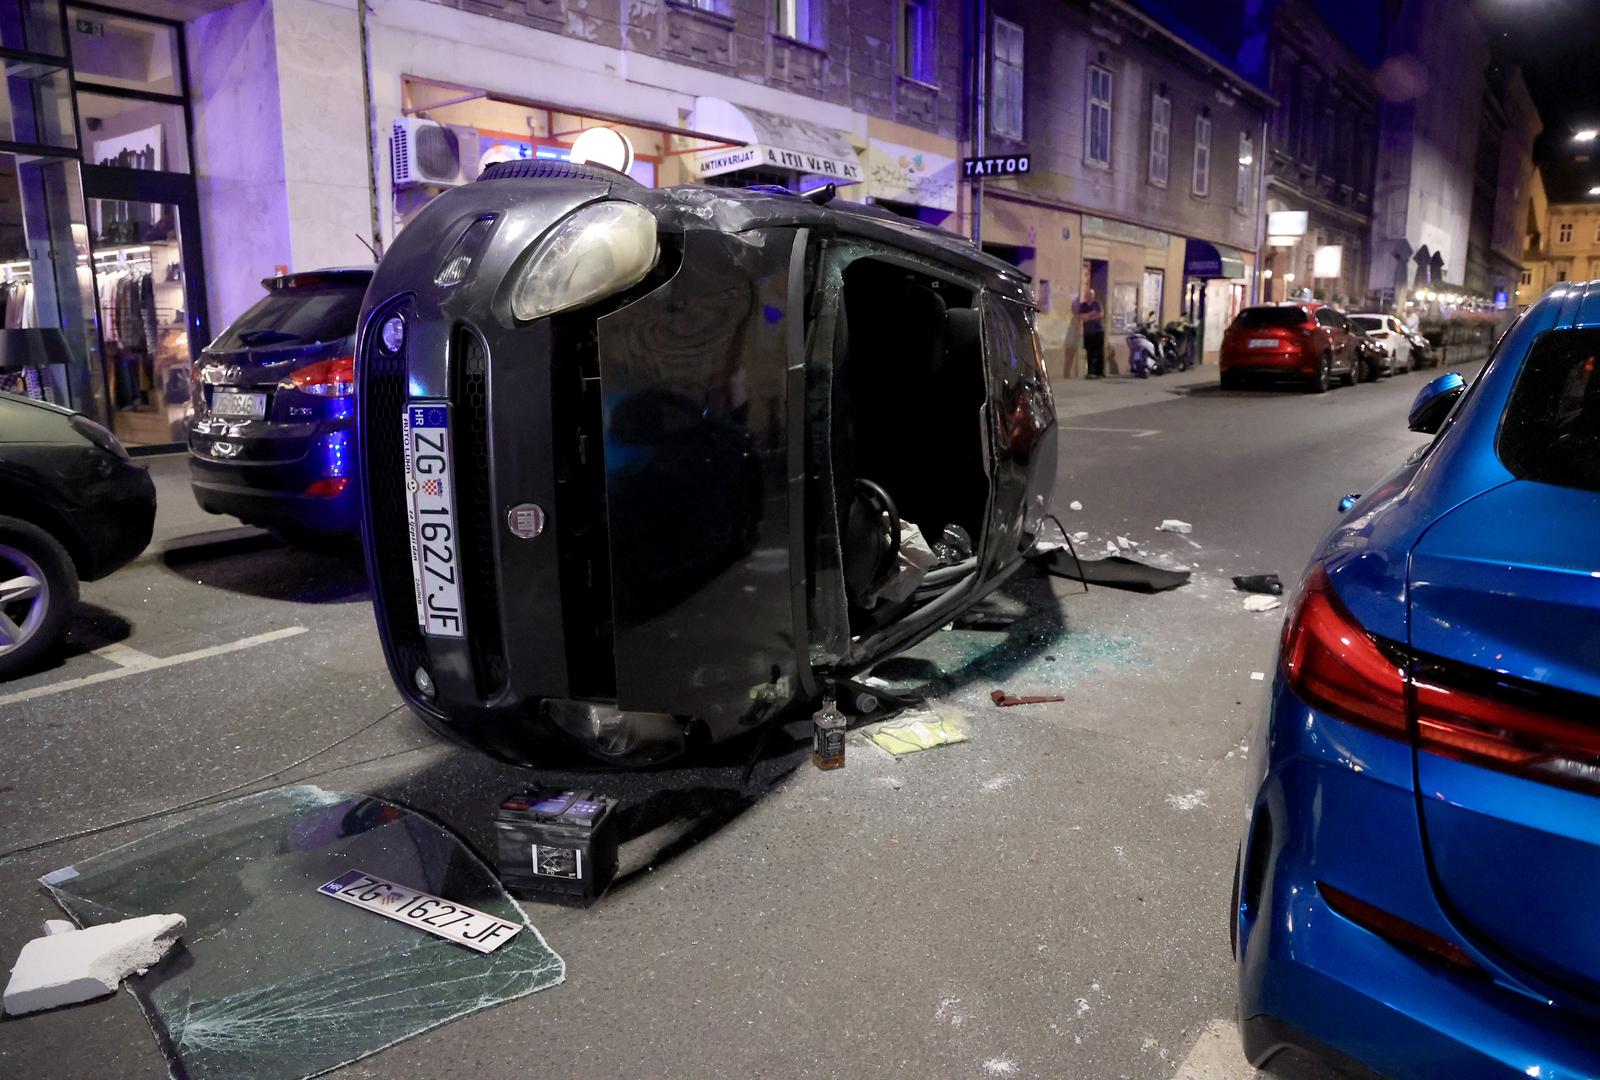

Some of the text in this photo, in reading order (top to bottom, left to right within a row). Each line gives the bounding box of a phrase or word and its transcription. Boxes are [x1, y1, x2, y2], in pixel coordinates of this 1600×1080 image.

[700, 150, 755, 172] ANTIKVARIJAT
[965, 158, 1029, 175] TATTOO
[414, 409, 424, 426] HR
[414, 432, 446, 475] ZG
[327, 882, 343, 893] HR
[341, 878, 392, 902] ZG
